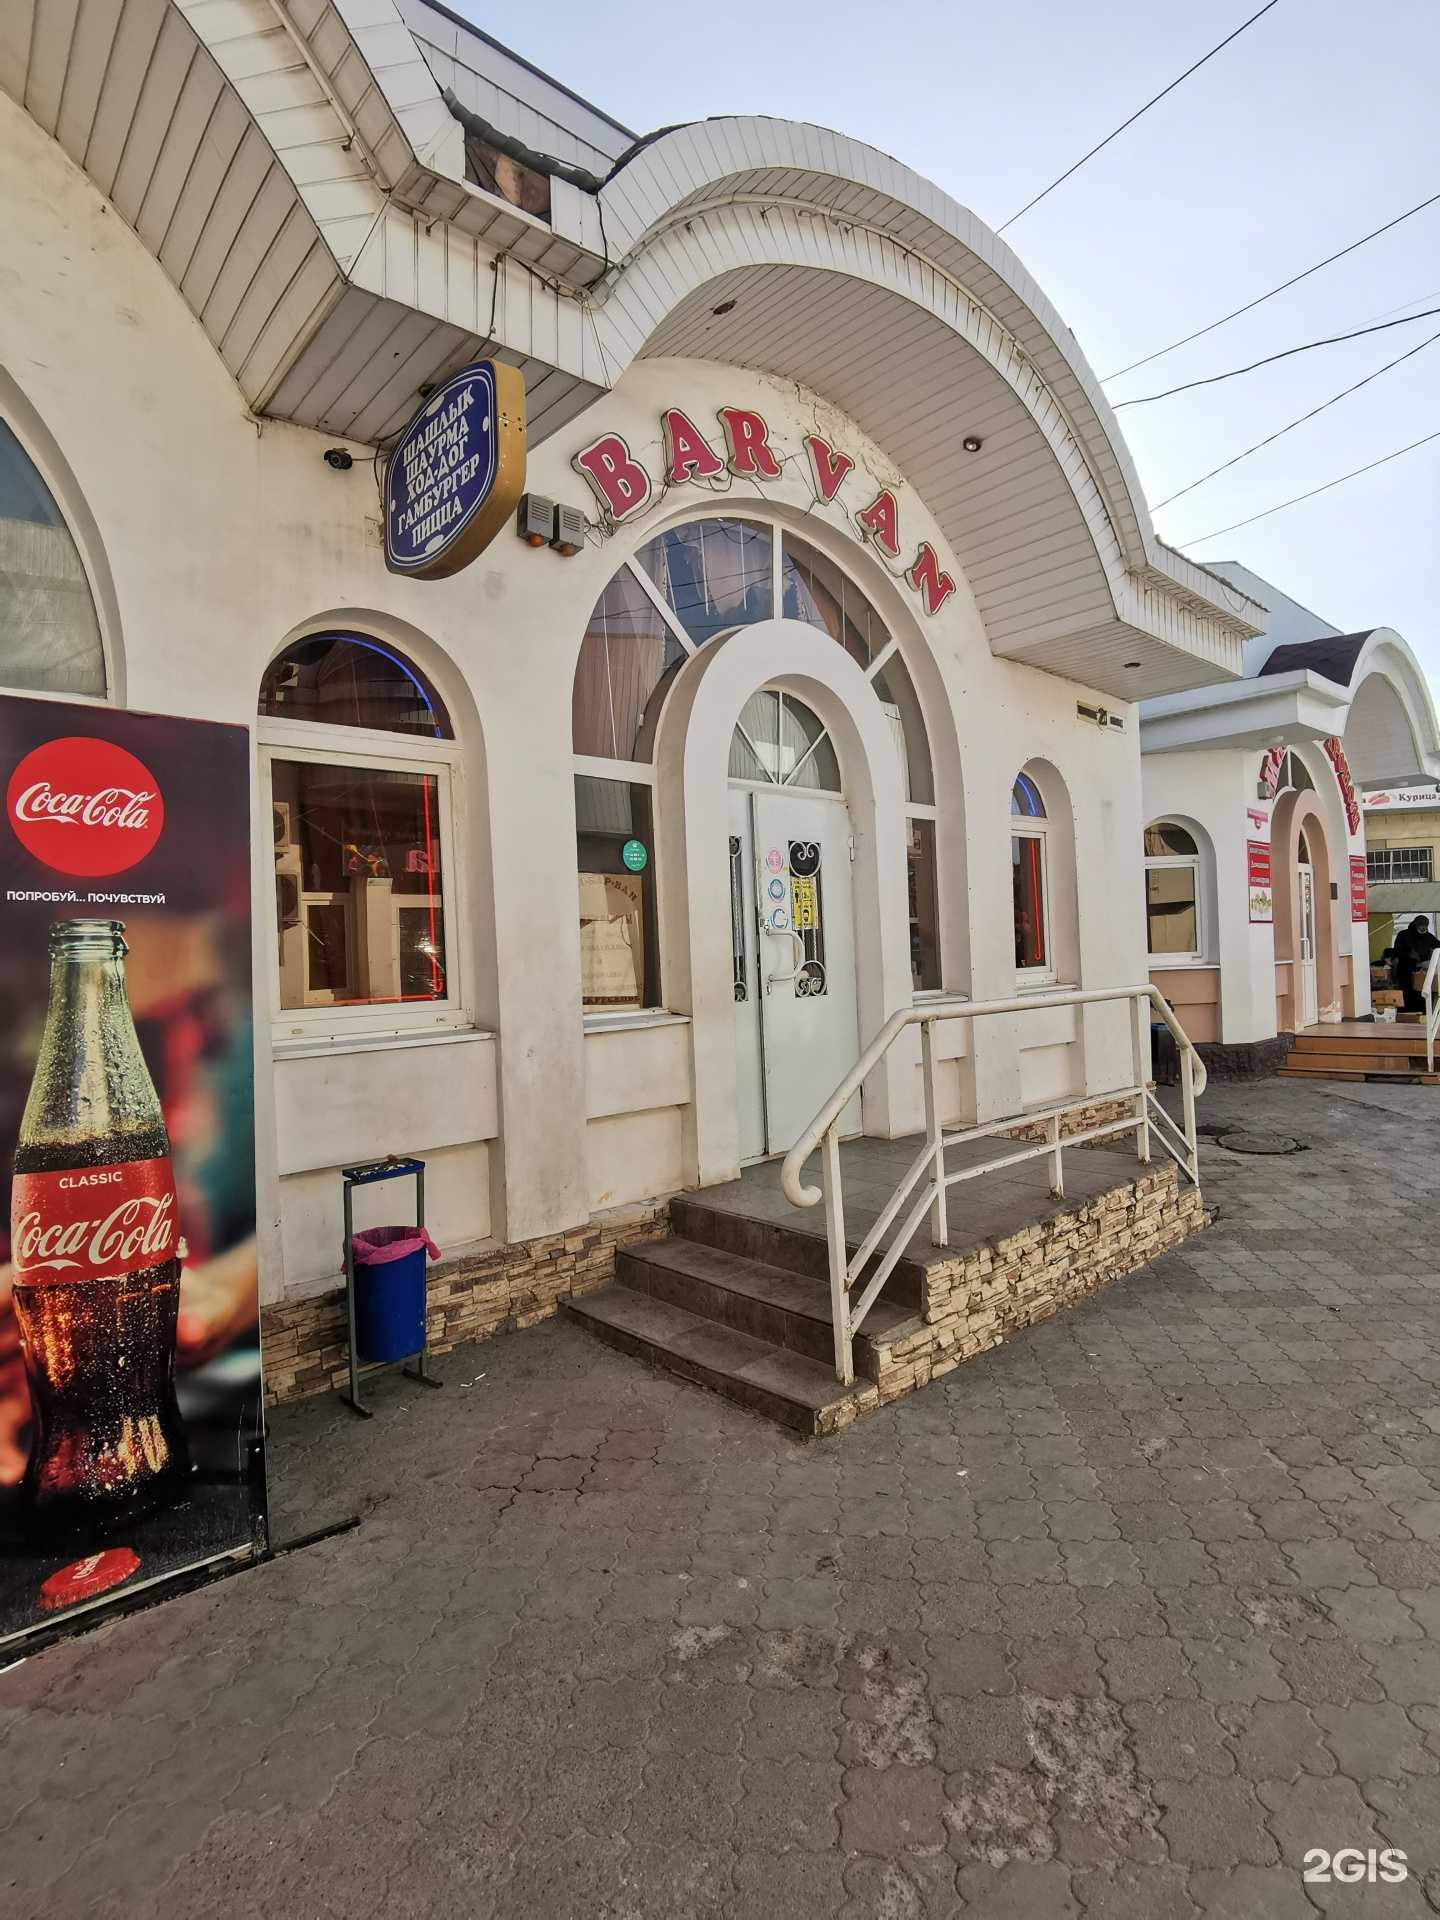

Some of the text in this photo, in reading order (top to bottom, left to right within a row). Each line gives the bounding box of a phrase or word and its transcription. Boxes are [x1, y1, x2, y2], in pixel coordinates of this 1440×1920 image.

[403, 384, 475, 467] ШАШЛЫК
[406, 416, 470, 484] ШАУРМА
[397, 453, 480, 535] ГАМБУРГЕР
[412, 495, 463, 548] ПИЦЦА
[571, 406, 957, 617] BAR VAN
[15, 782, 157, 829] Coca-Cola
[1398, 793, 1437, 802] Курица
[87, 892, 166, 904] ПОЧУВСТВУЙ
[58, 1171, 123, 1189] CLASSIC
[12, 1192, 175, 1273] Coca-Cola
